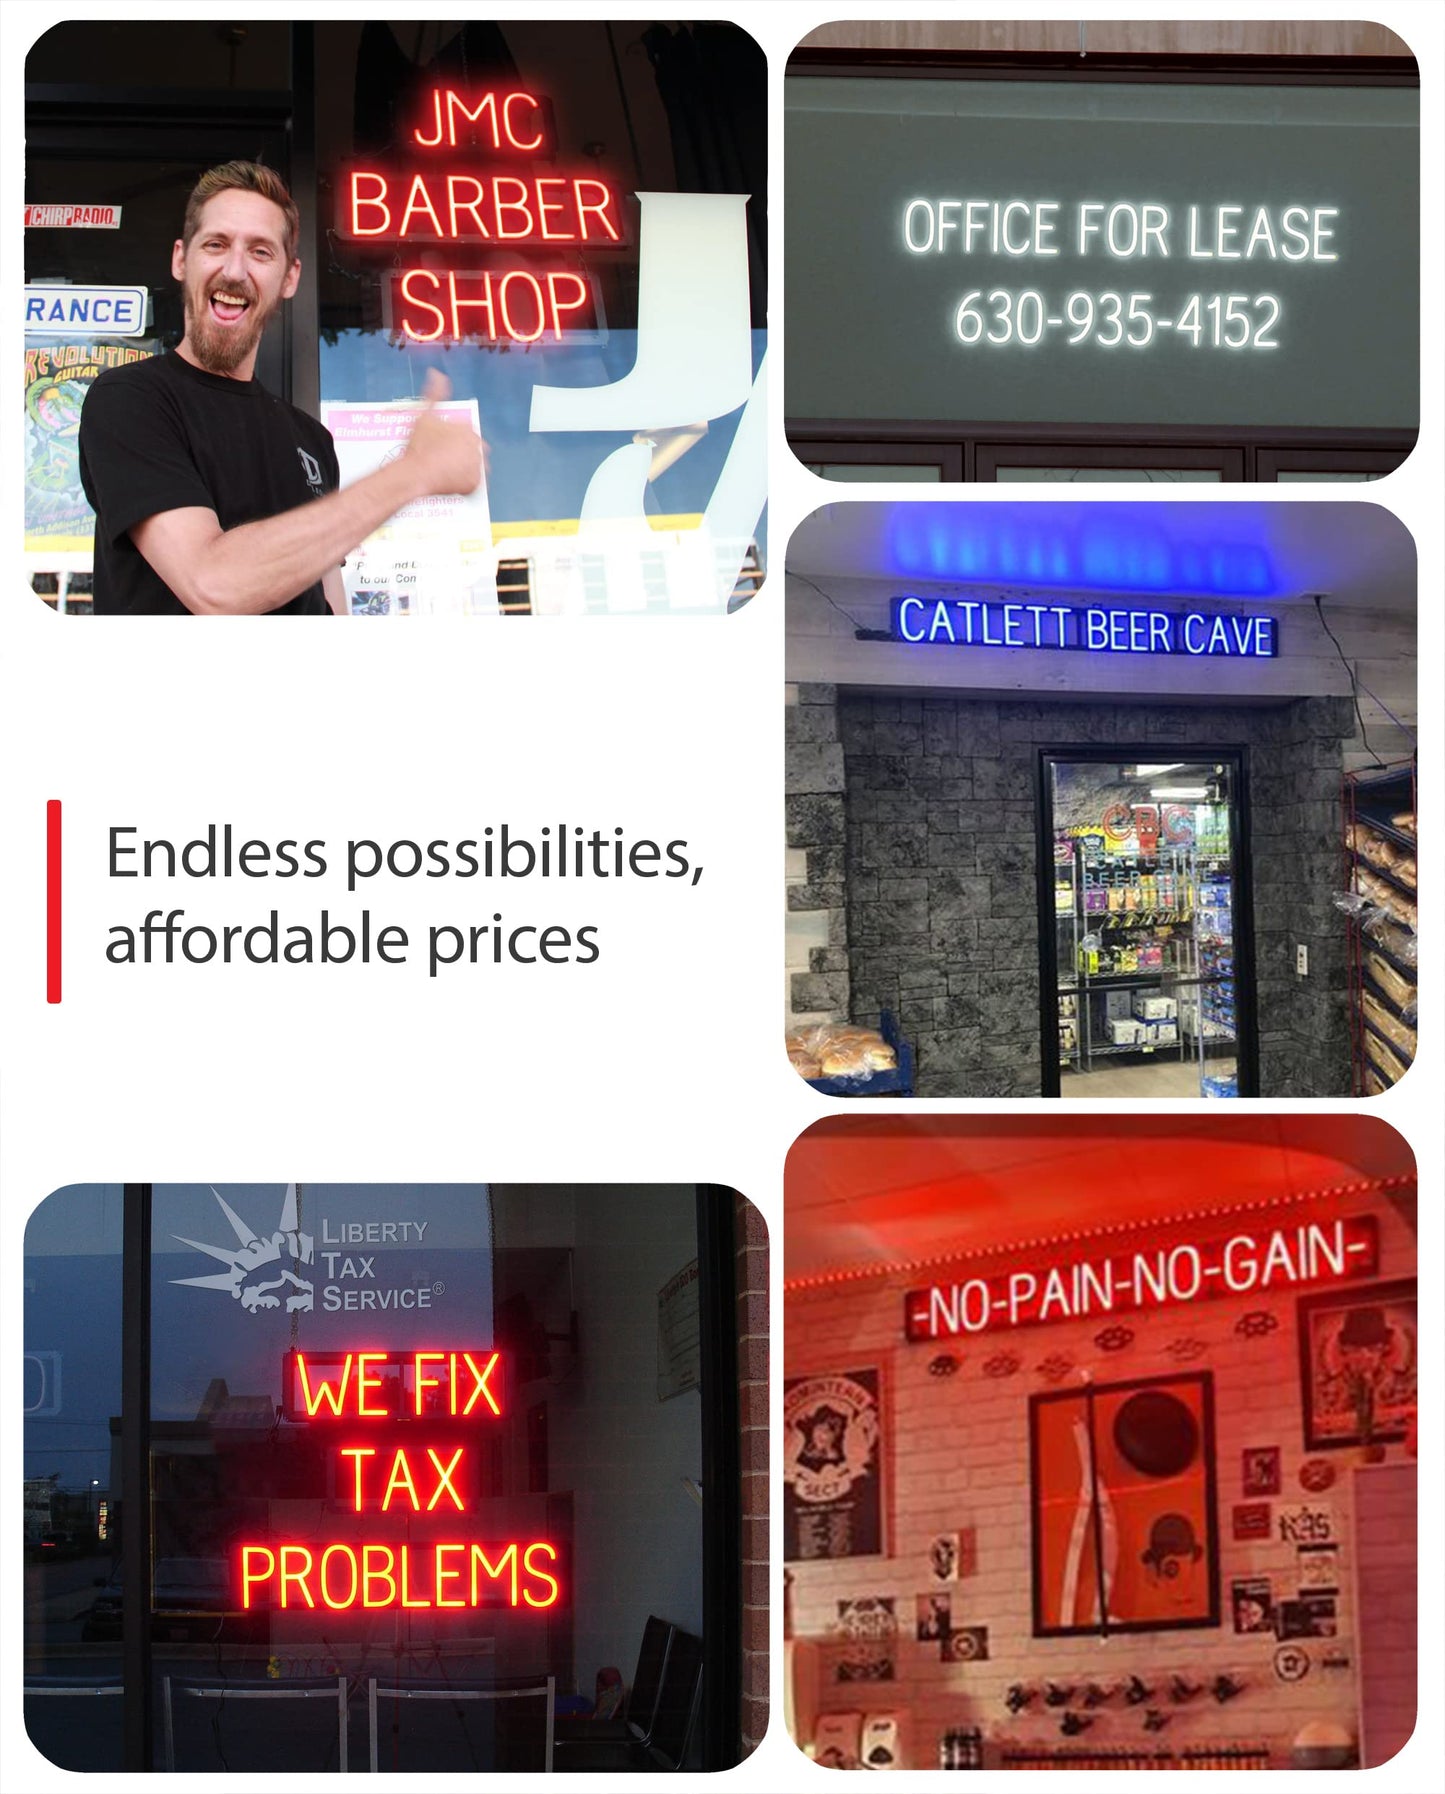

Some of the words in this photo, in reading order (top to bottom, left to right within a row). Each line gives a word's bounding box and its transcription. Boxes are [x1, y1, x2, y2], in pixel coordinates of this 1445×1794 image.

[413, 88, 543, 150] JMC
[351, 171, 619, 241] BARBER
[904, 200, 1059, 255] OFFICE
[1080, 203, 1169, 257] FOR
[1190, 207, 1339, 261] LEASE
[25, 297, 134, 323] RANCE
[400, 269, 587, 342] SHOP
[956, 291, 1281, 348] 630-935-4152
[334, 425, 391, 438] Elmhurst
[351, 413, 370, 424] We
[373, 413, 418, 425] Suppor
[899, 597, 1072, 649] CATLETT
[1087, 608, 1171, 653] BEER
[1184, 613, 1273, 656] CAVE
[1102, 802, 1193, 842] CBC
[322, 1218, 428, 1244] LIBERTY
[321, 1252, 376, 1279] TAX
[297, 1353, 388, 1417] WE
[415, 1353, 501, 1416] FIX
[341, 1449, 465, 1512] TAX
[242, 1542, 559, 1610] PROBLEMS
